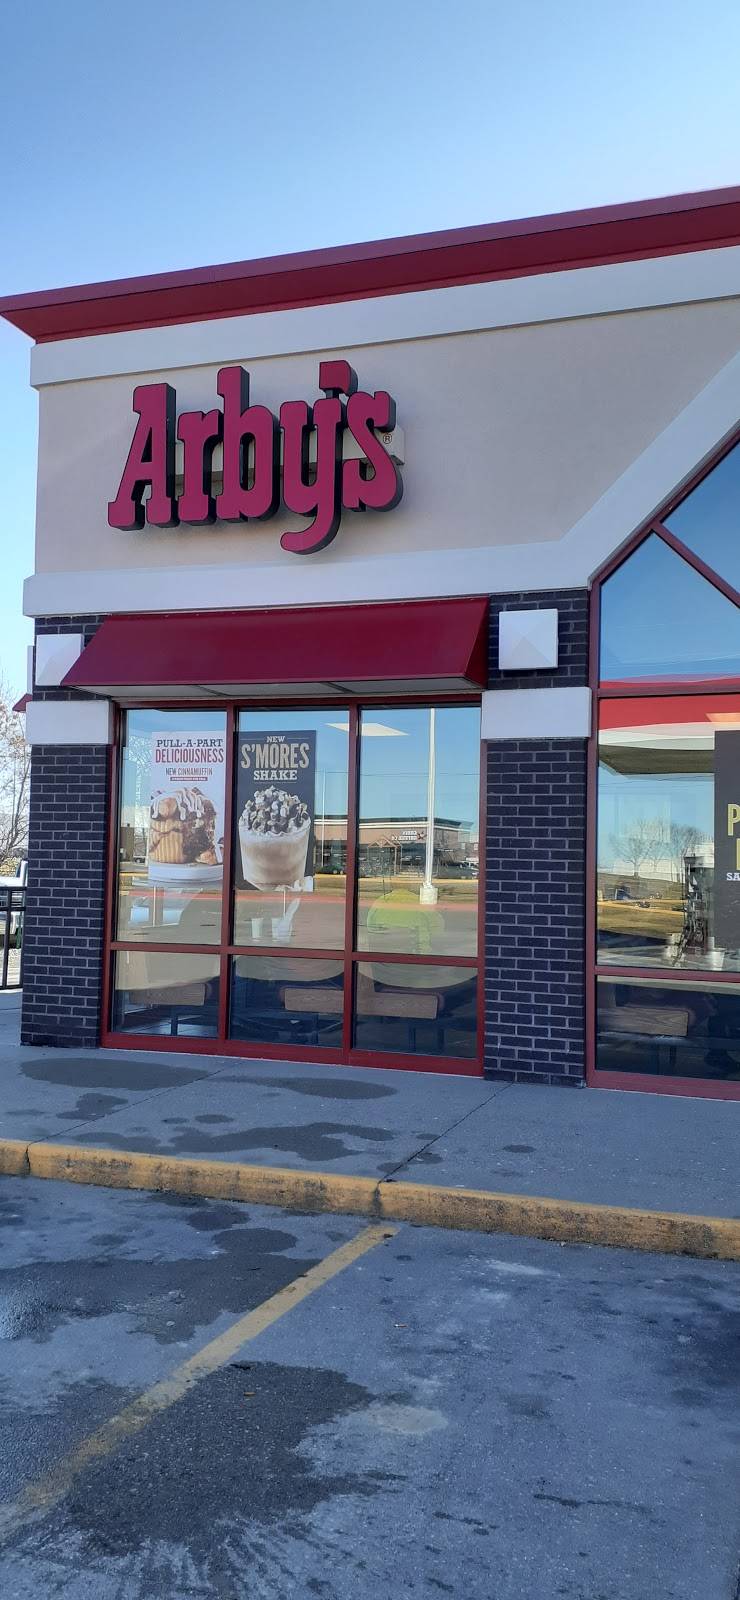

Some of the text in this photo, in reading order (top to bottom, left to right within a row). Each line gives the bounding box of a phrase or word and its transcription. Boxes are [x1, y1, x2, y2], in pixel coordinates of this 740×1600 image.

[108, 360, 402, 553] Arby's
[156, 739, 223, 748] PULL-A-PART
[156, 748, 224, 763] DELICIOUSNESS
[241, 743, 309, 768] S'MORES
[253, 770, 298, 780] SHAKE
